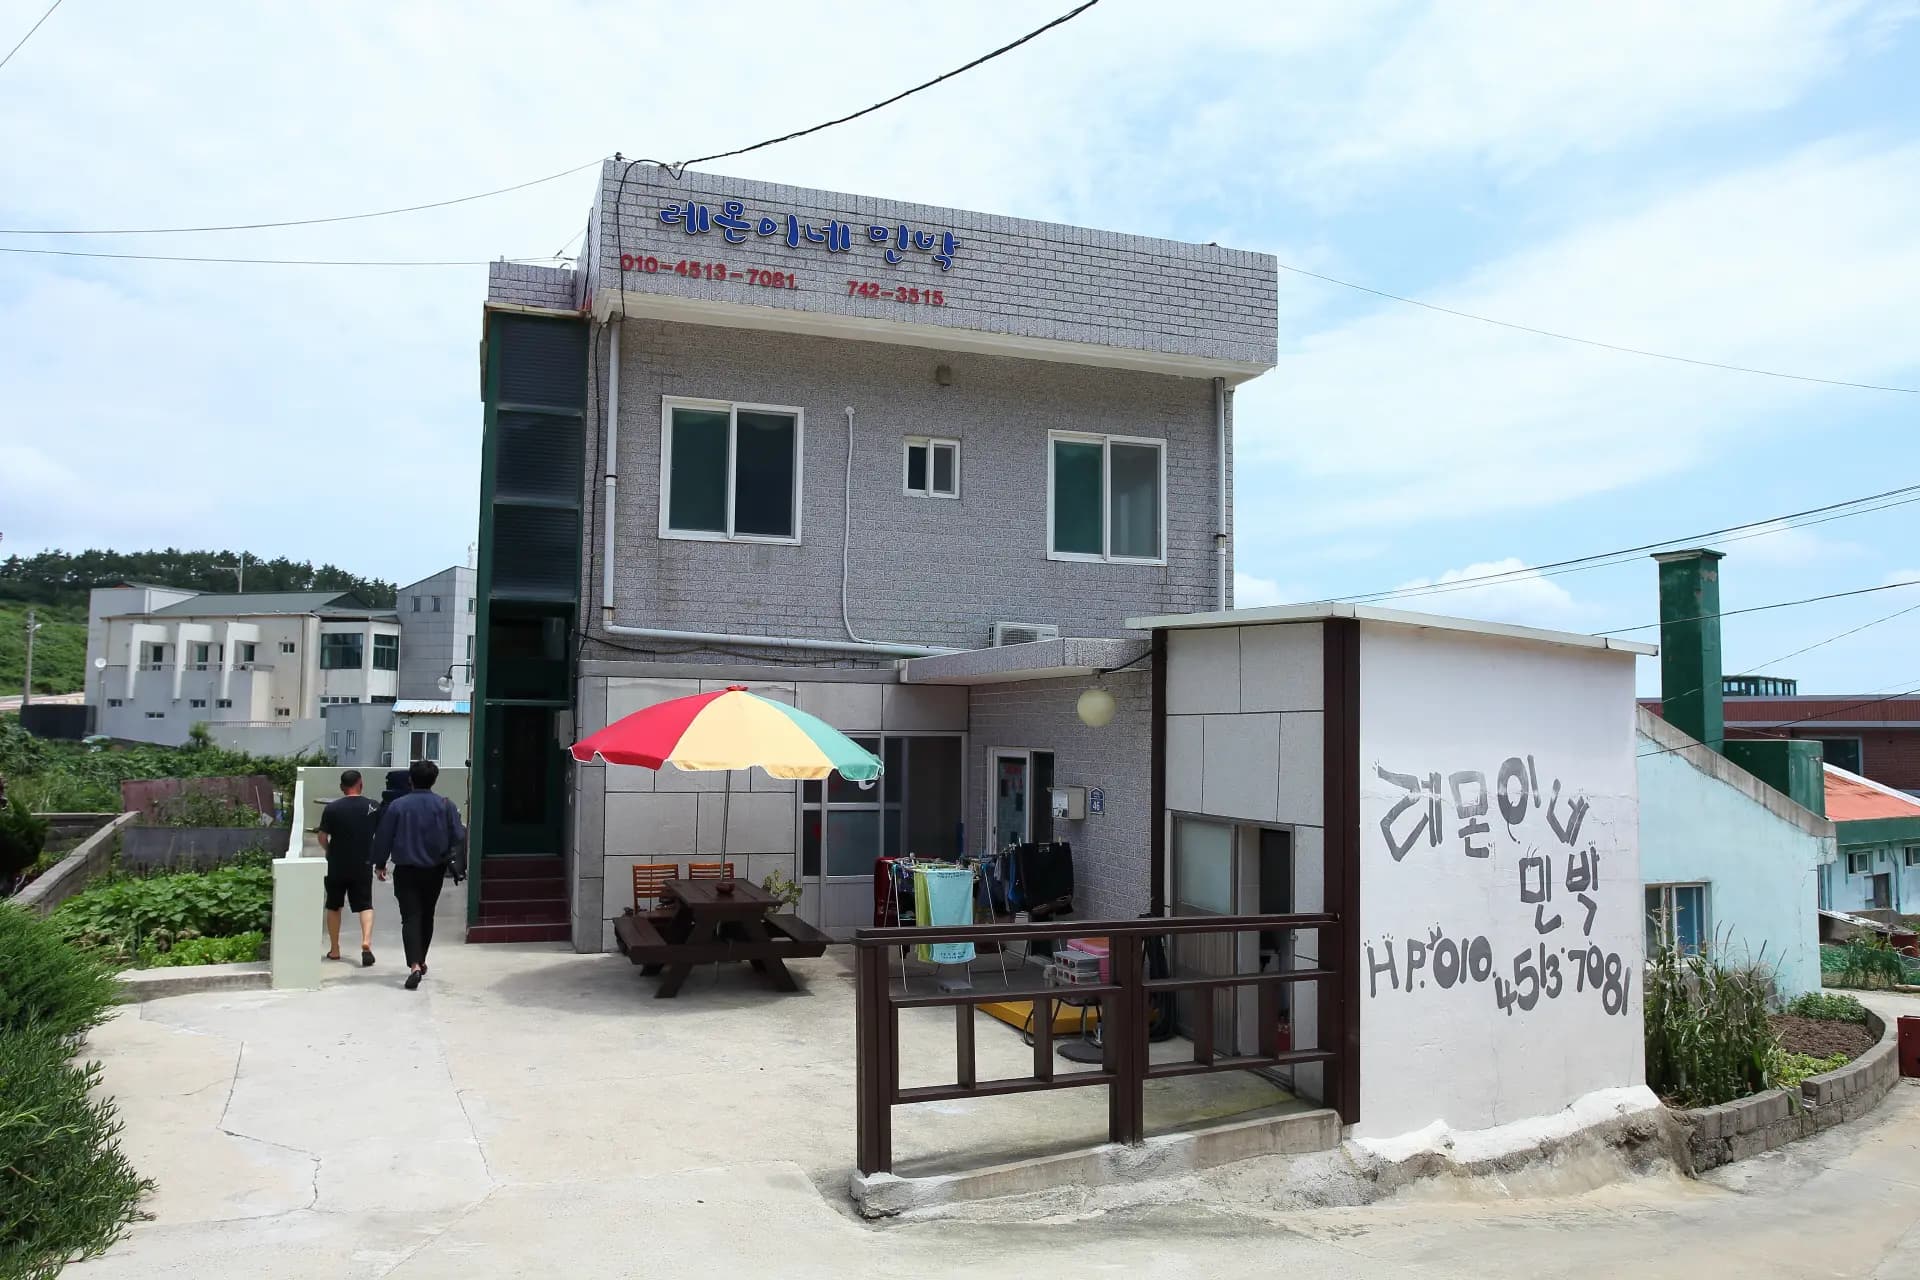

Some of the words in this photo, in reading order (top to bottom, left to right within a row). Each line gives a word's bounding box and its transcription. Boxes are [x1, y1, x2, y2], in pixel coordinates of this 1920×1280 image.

[869, 224, 961, 271] 민박
[620, 254, 795, 289] 010-4513-7081
[847, 280, 945, 306] 742-3515
[1518, 846, 1600, 935] 민박
